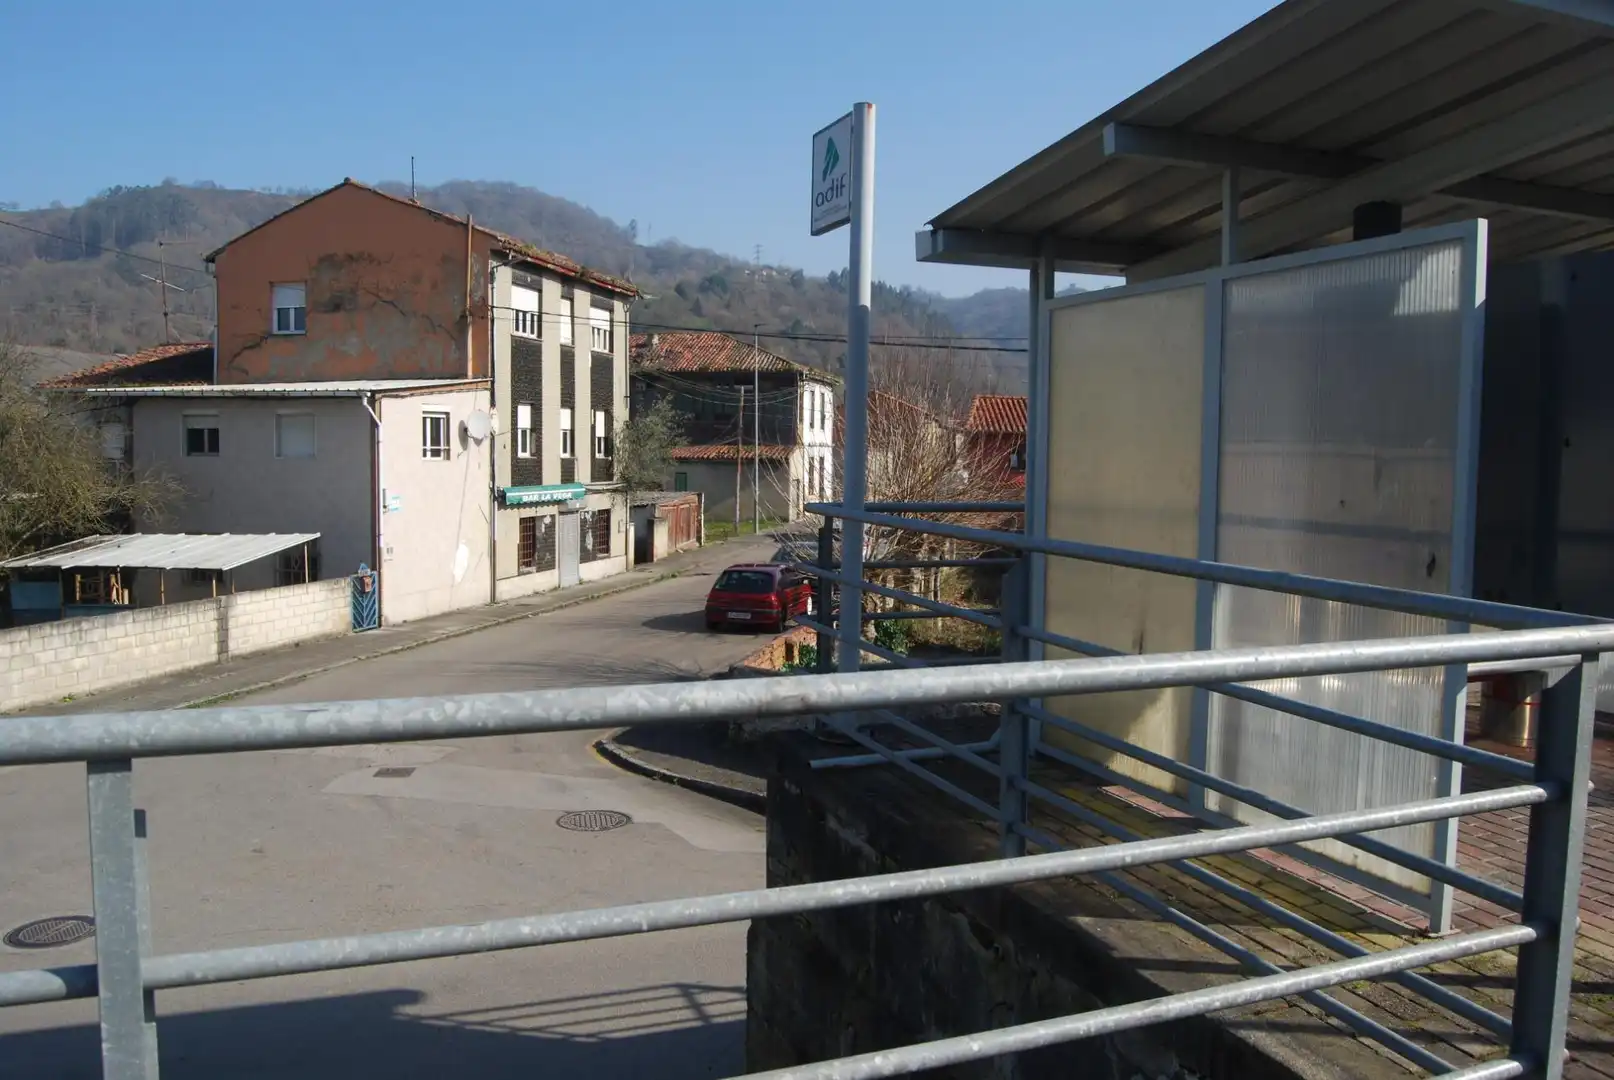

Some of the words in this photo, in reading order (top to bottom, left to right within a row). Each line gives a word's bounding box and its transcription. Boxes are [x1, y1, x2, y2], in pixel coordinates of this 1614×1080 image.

[816, 173, 847, 207] adif
[522, 494, 539, 502] BAR
[541, 493, 551, 501] LA
[552, 492, 572, 500] VEGA
